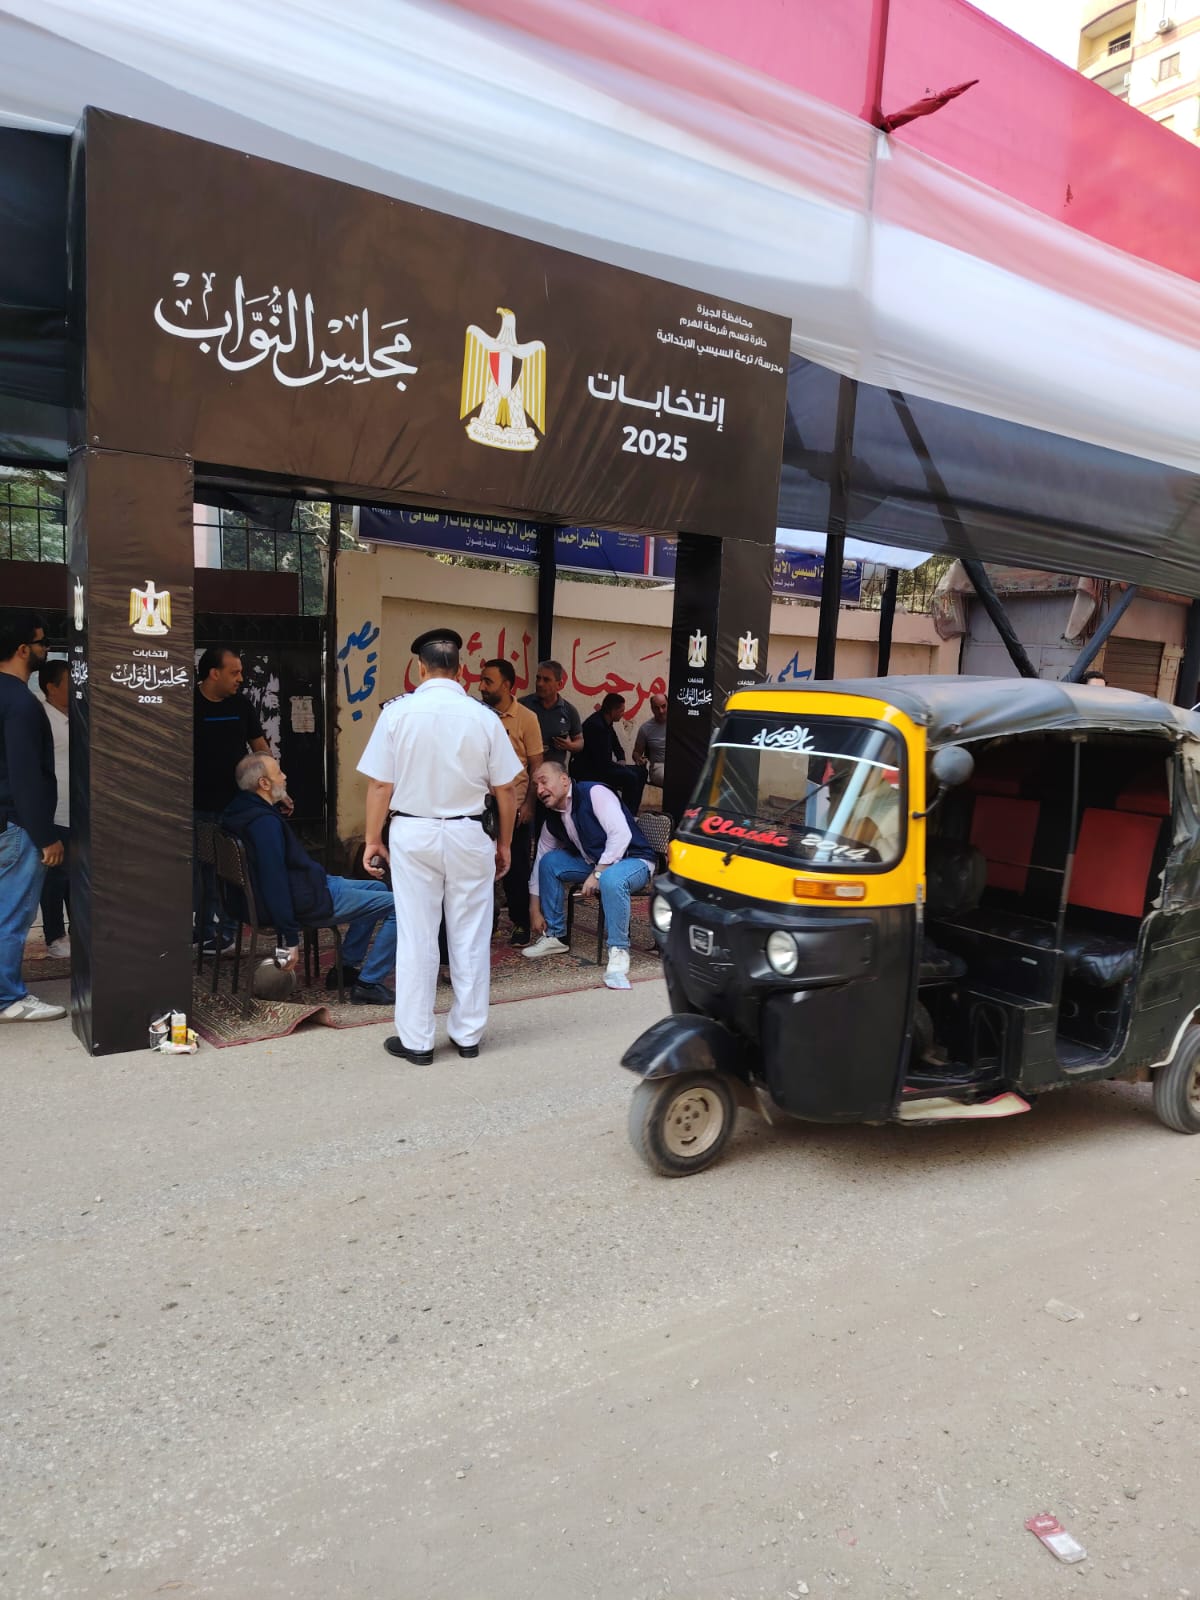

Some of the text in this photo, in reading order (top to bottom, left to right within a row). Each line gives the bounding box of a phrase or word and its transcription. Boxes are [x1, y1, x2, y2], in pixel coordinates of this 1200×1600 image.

[680, 317, 703, 329] الهرم
[697, 304, 753, 328] محافظة الجيزة
[657, 329, 695, 350] الابتدائية
[704, 322, 727, 336] شرطة
[728, 330, 750, 342] قسم
[734, 349, 753, 365] ترعة
[587, 372, 725, 432] إنتخابات
[622, 425, 688, 462] 2025
[337, 621, 380, 660] مصر
[138, 695, 163, 704] 2025
[701, 815, 789, 847] Classic
